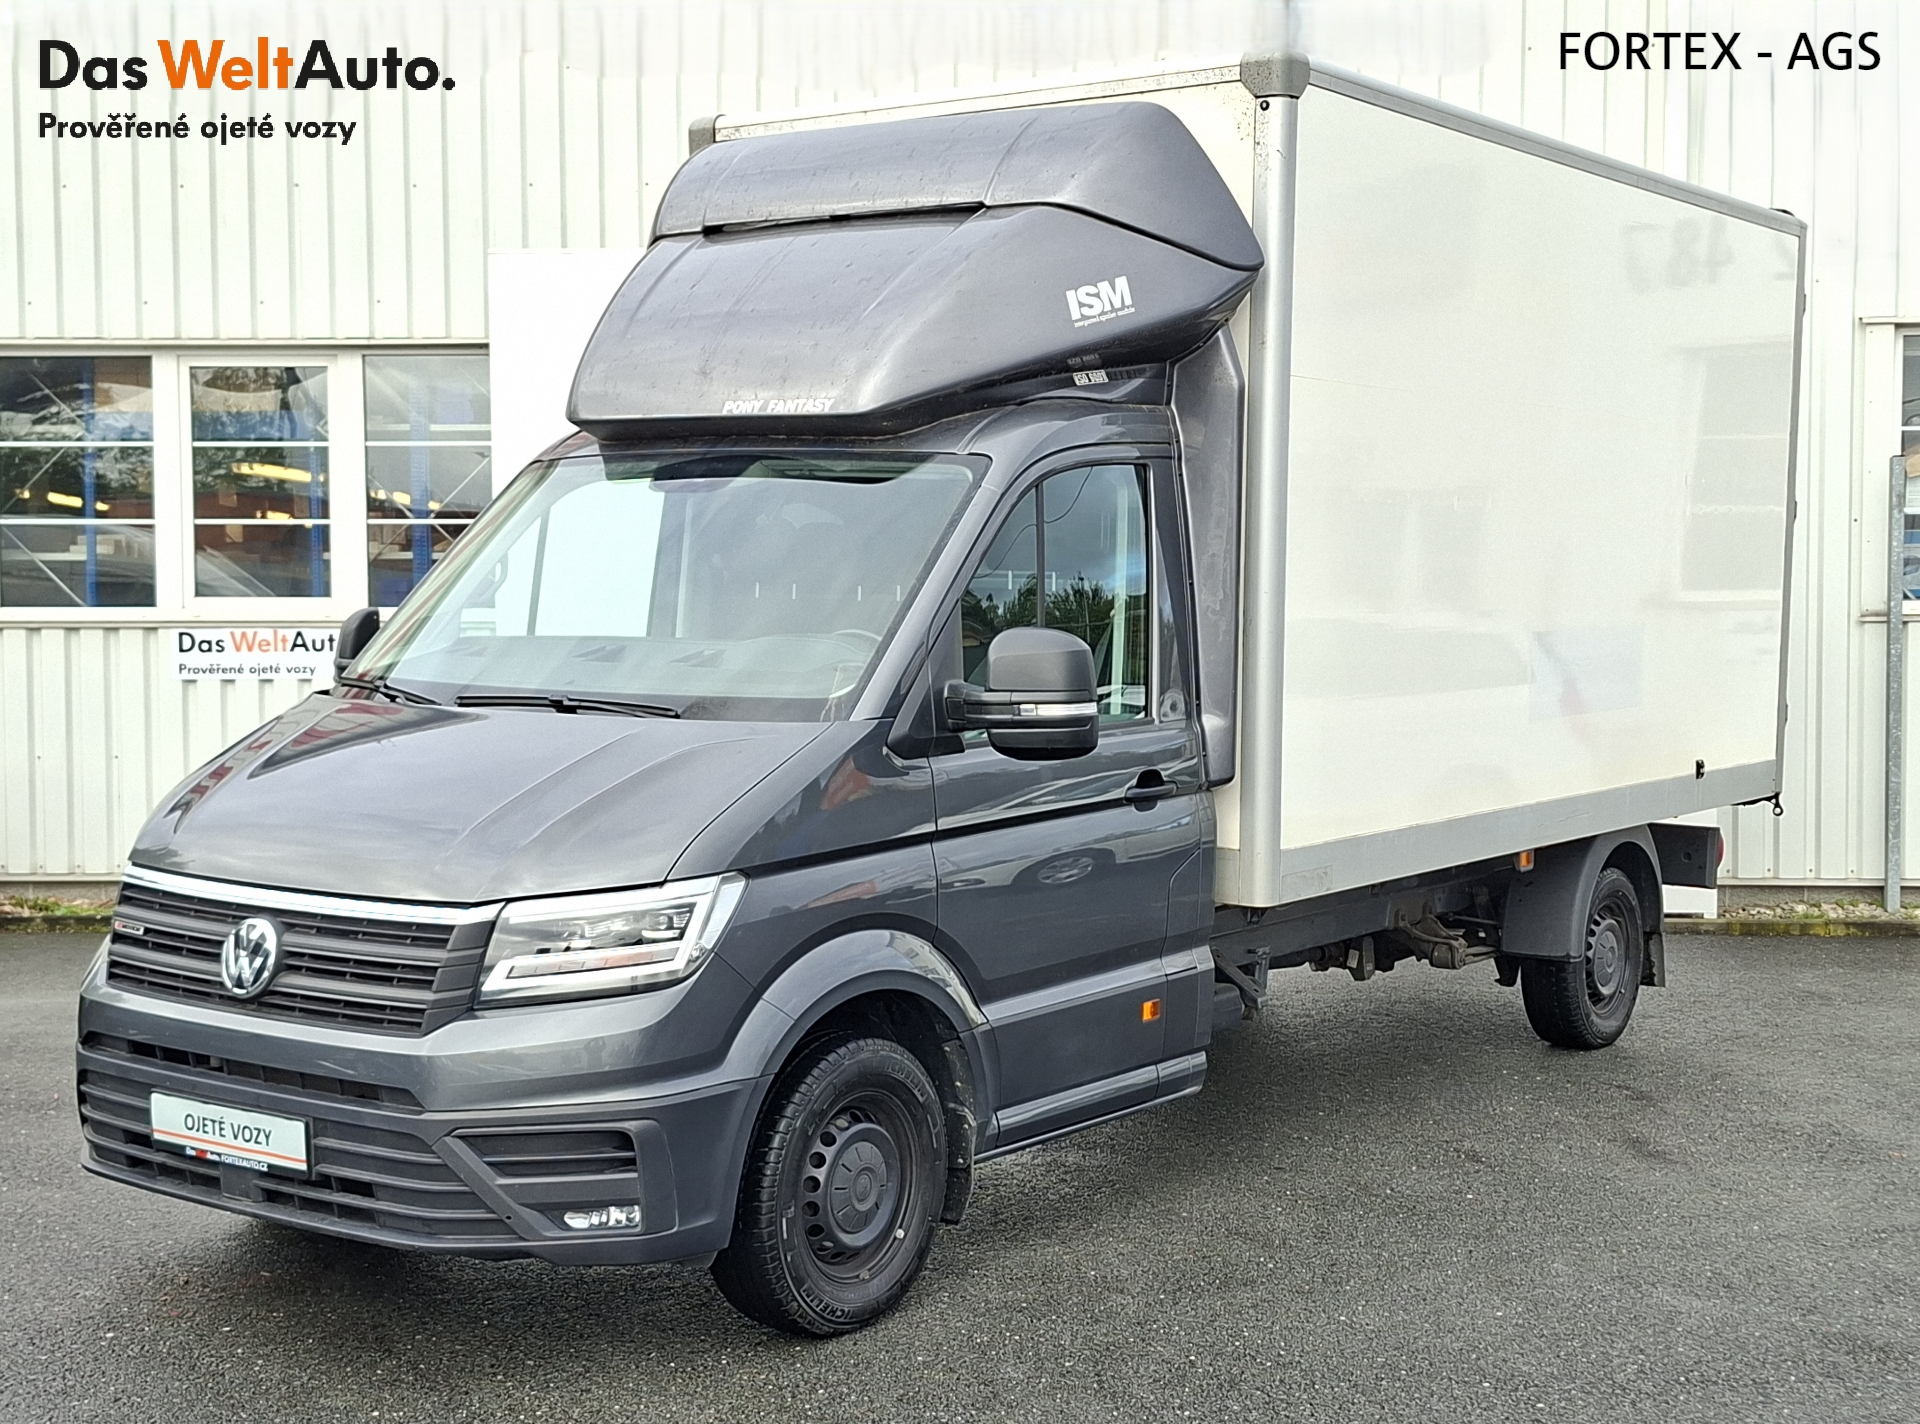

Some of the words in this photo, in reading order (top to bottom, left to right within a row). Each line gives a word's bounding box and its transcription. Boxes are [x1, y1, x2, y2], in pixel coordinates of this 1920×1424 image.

[1065, 275, 1133, 321] ISM
[722, 399, 764, 414] PONY
[766, 398, 835, 413] FANTASY
[178, 632, 225, 653] Das
[230, 629, 336, 653] WeltAut
[178, 663, 244, 675] Prověřené
[249, 663, 281, 677] ojeté
[286, 666, 317, 677] vozy
[184, 1113, 227, 1138] OJETÉ
[230, 1122, 272, 1147] VOZY
